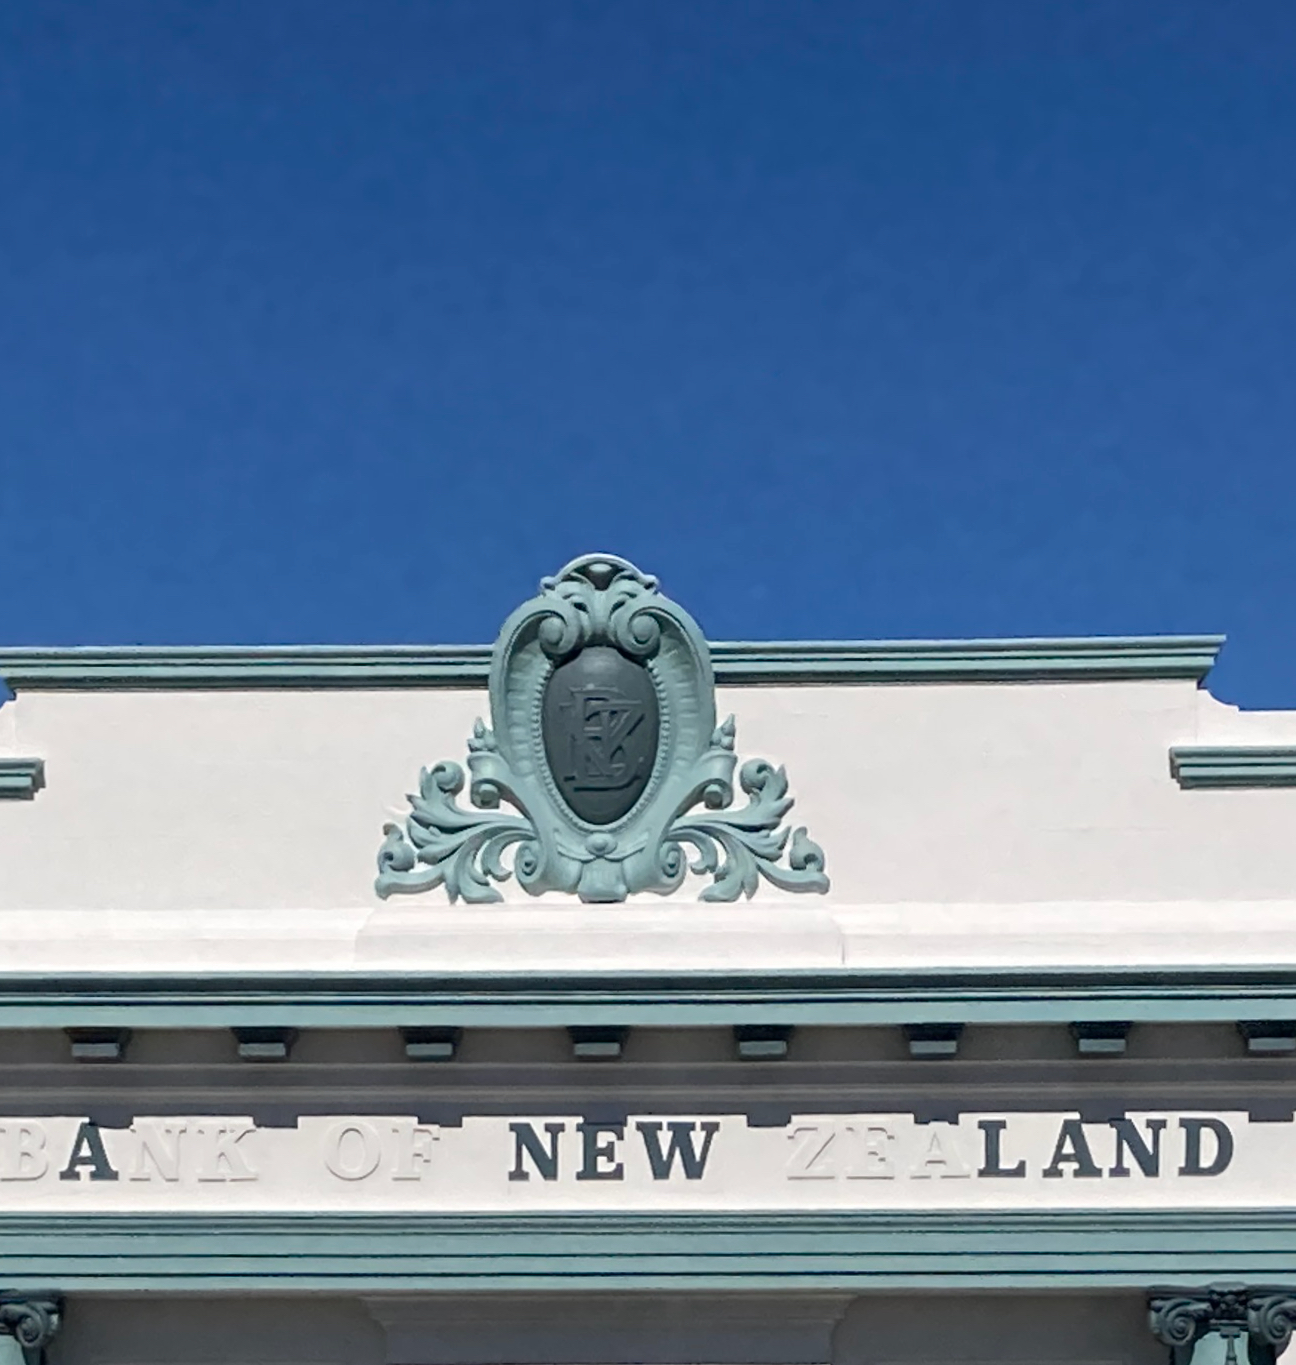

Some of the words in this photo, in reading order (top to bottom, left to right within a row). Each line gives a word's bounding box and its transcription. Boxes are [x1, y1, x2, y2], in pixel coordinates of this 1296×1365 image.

[325, 1121, 440, 1182] OF
[508, 1121, 721, 1181] NEW
[786, 1119, 1235, 1180] ZEALAND
